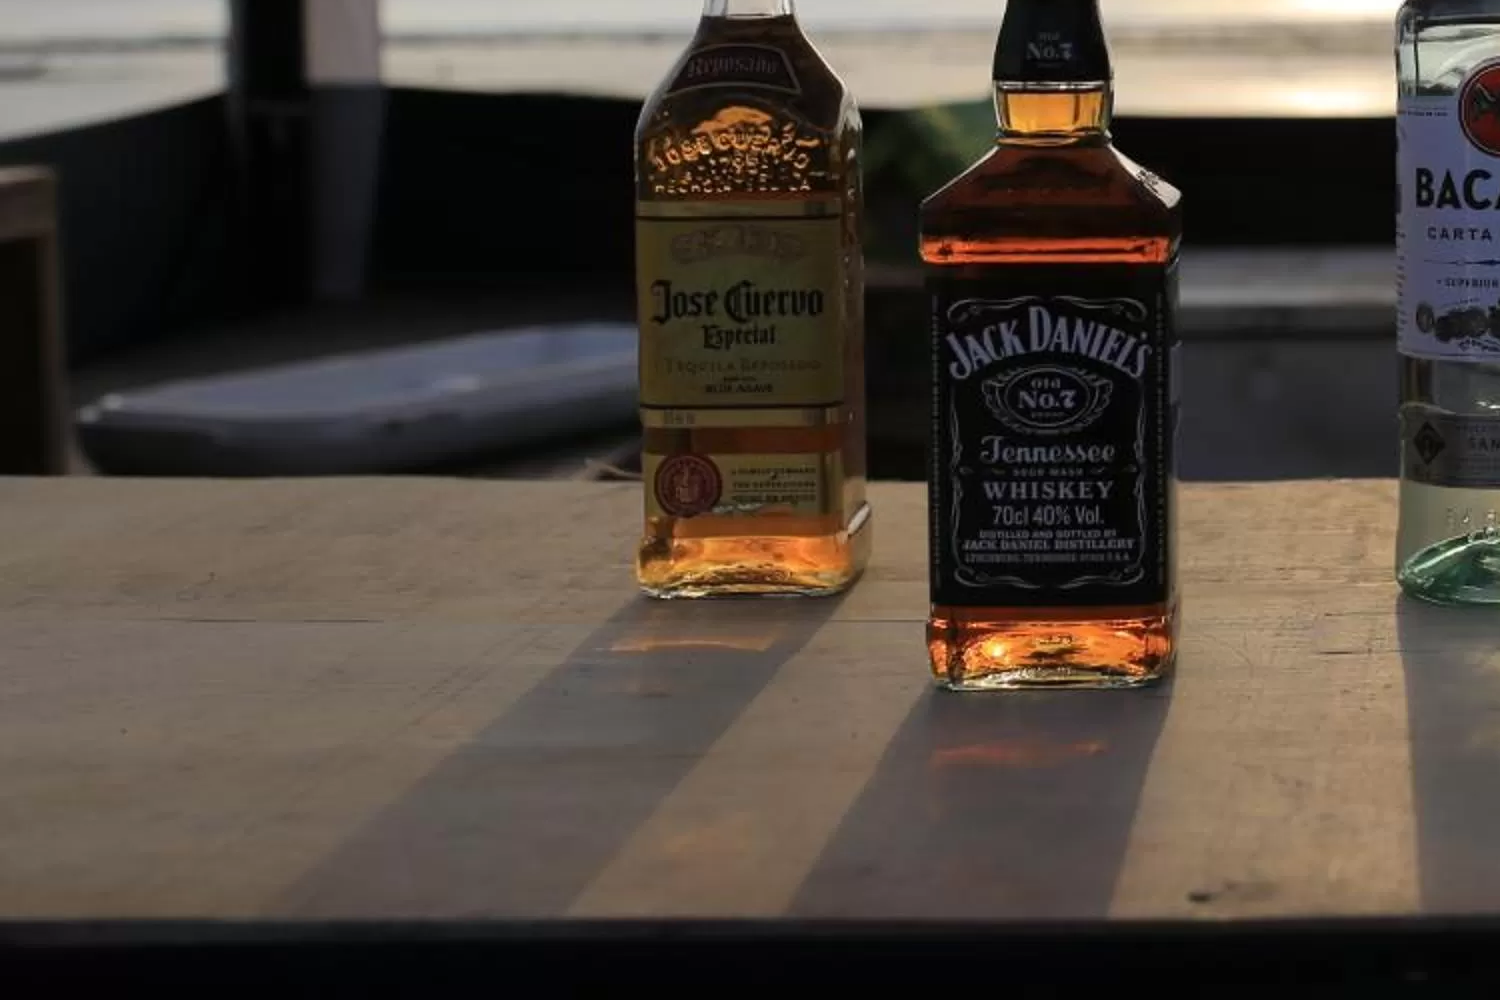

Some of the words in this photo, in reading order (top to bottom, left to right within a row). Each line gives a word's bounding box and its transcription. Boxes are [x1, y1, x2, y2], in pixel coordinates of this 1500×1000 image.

[1427, 226, 1492, 240] CARTA
[649, 278, 719, 325] Jose
[723, 280, 824, 324] Cuervo
[945, 318, 1026, 380] JACK
[1028, 305, 1152, 379] DANIEL'S
[980, 435, 1116, 464] Tennessee
[982, 480, 1115, 500] WHISKEY
[992, 505, 1029, 525] 70cl
[1032, 504, 1072, 525] 40%
